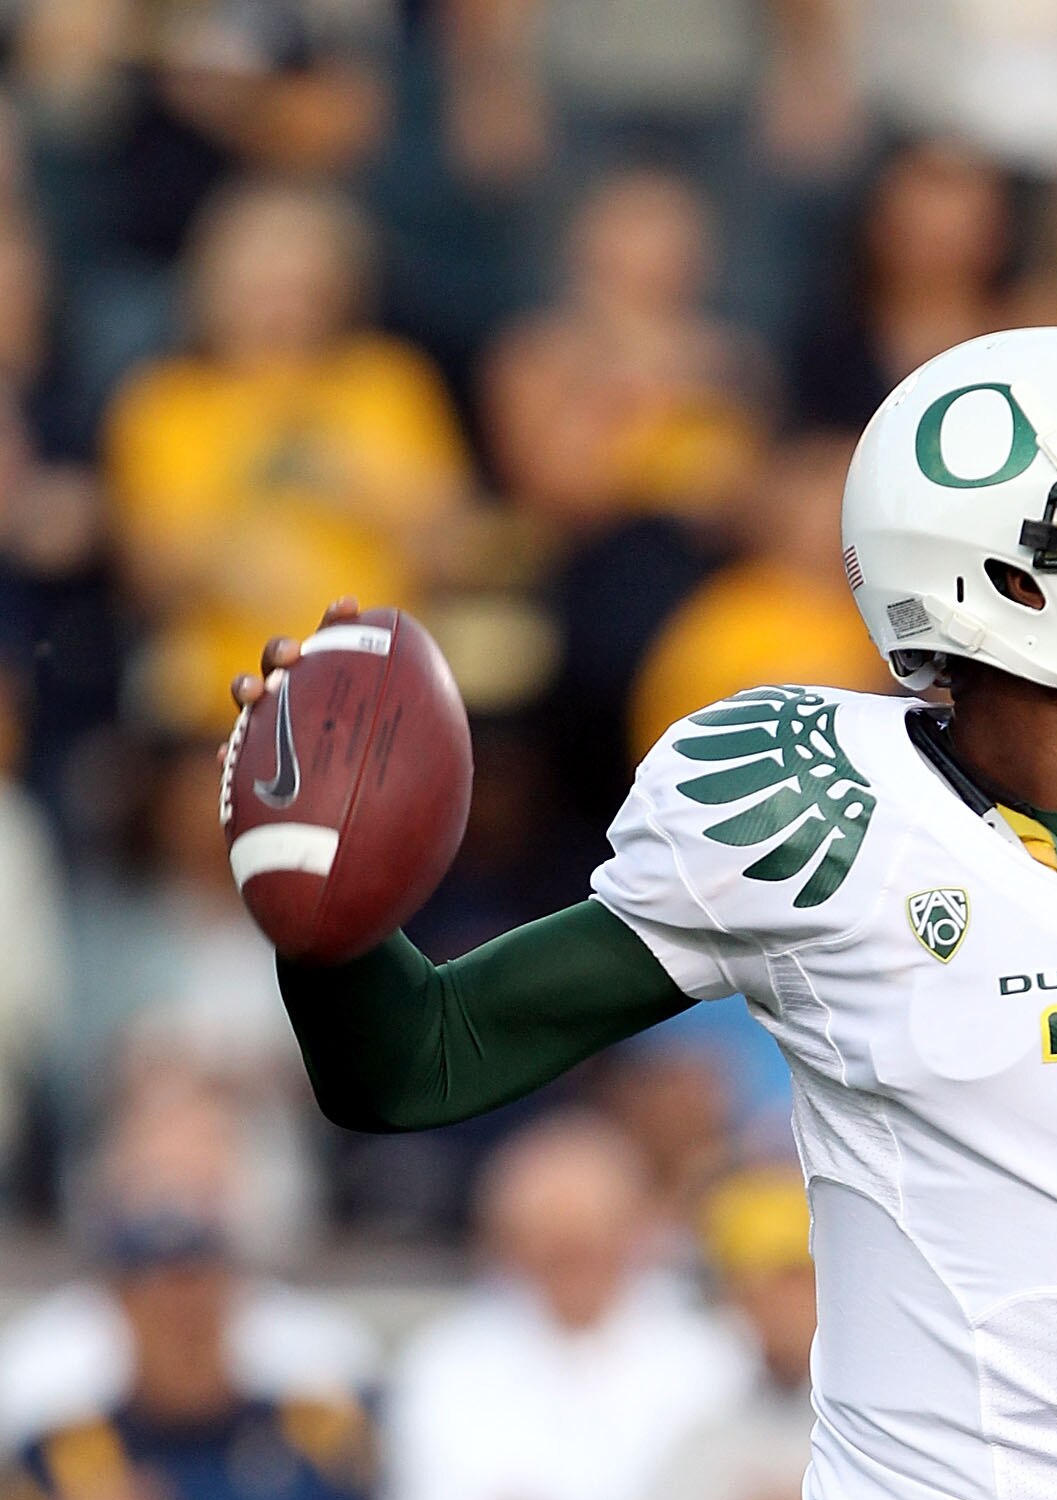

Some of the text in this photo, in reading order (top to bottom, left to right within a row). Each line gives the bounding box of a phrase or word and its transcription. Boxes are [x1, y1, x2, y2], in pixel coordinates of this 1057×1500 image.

[915, 383, 1039, 488] O
[910, 890, 967, 936] PAC
[927, 918, 961, 949] 10
